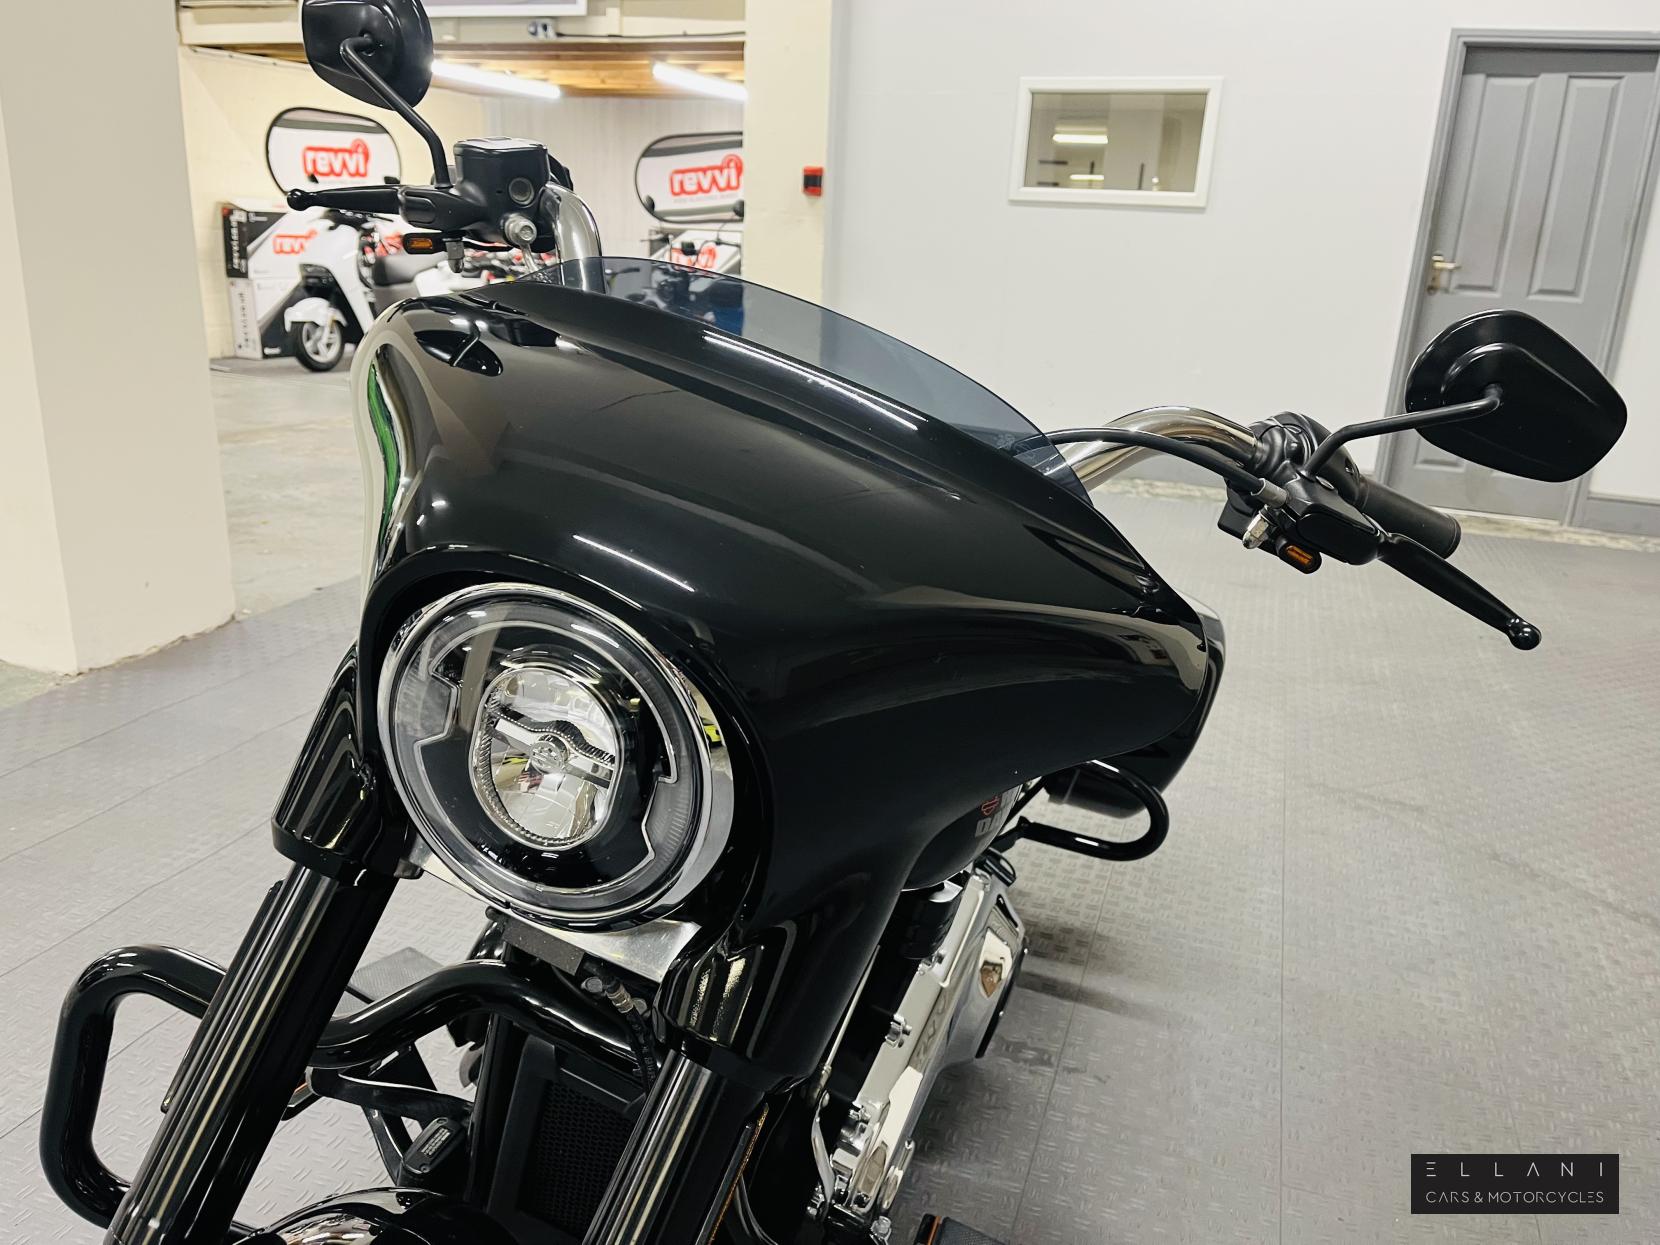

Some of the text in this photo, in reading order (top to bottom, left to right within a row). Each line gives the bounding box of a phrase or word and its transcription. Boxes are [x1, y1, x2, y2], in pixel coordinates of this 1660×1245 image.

[303, 139, 369, 177] revvi
[670, 154, 743, 196] revvi
[273, 230, 317, 255] revv
